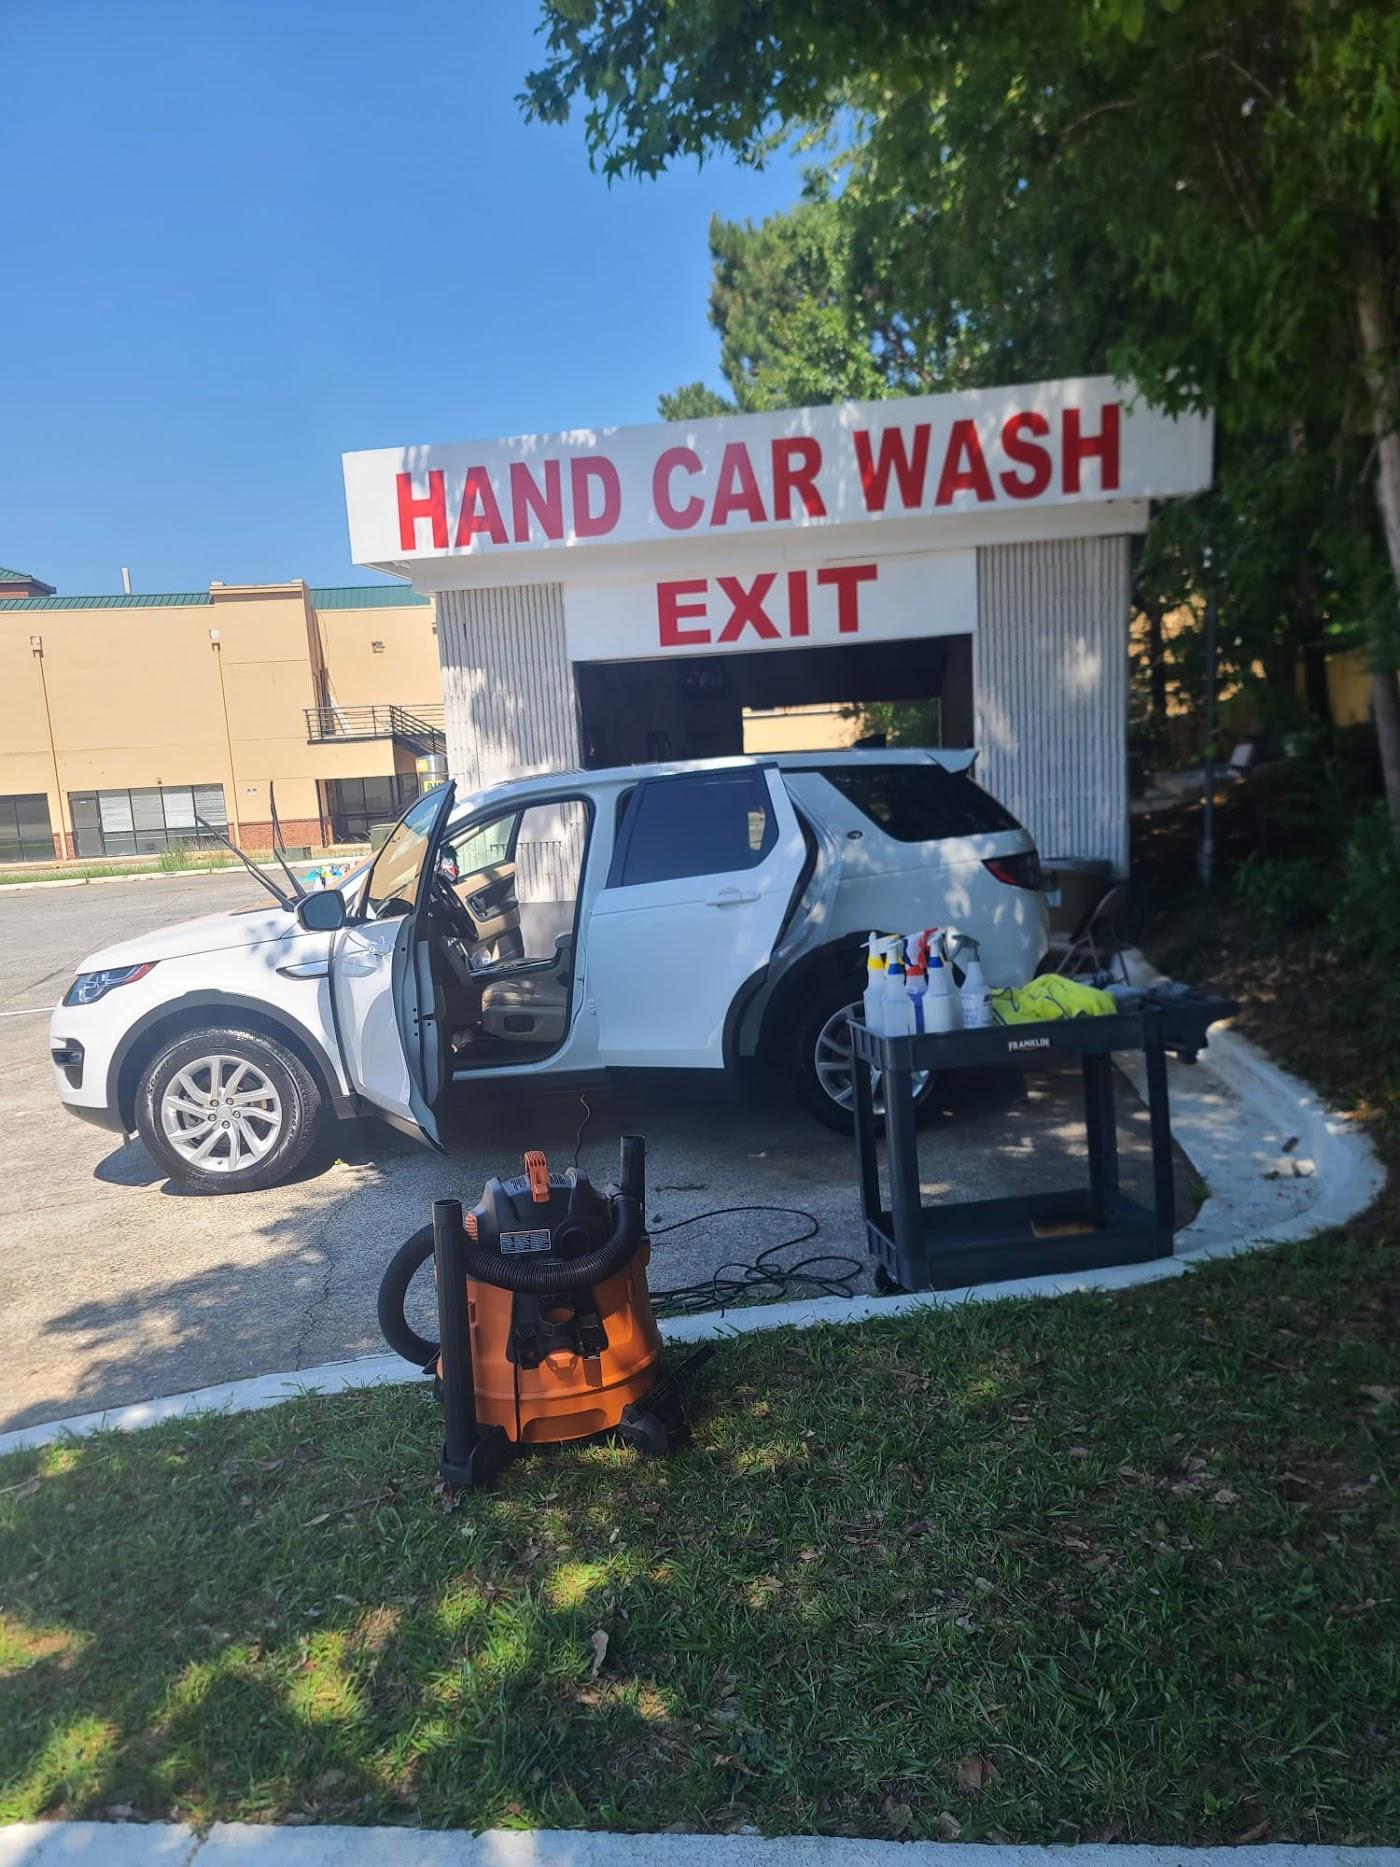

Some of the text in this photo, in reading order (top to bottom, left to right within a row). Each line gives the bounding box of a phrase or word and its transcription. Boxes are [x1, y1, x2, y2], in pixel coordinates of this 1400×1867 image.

[396, 404, 1120, 551] HAND CAR WASH
[656, 564, 877, 647] EXIT
[1008, 1037, 1050, 1052] FRANKLIN
